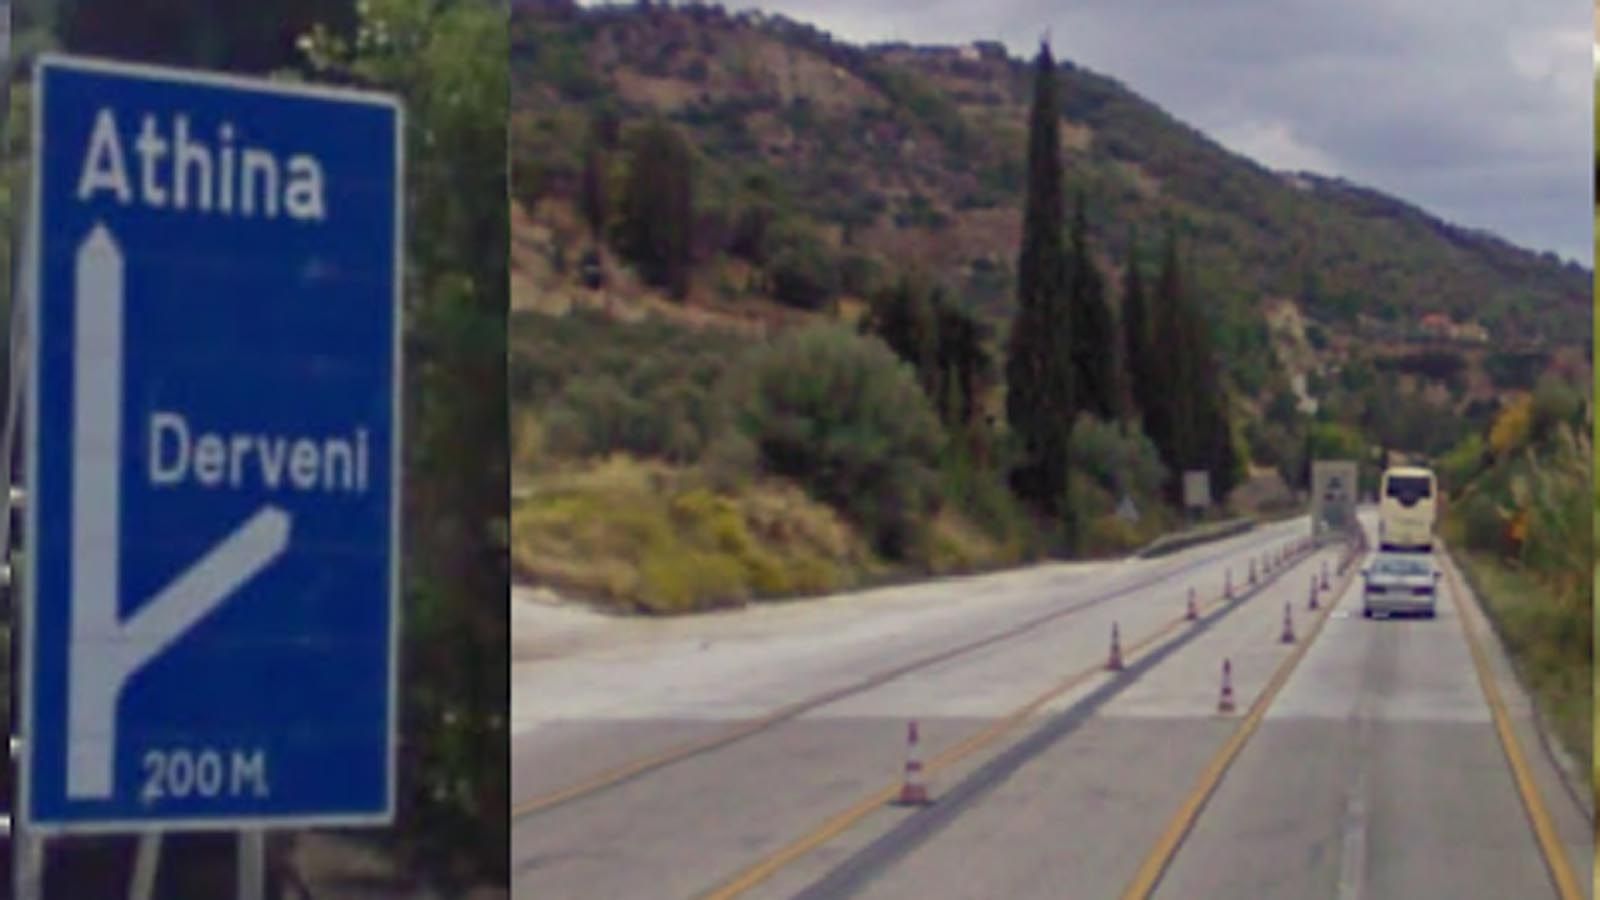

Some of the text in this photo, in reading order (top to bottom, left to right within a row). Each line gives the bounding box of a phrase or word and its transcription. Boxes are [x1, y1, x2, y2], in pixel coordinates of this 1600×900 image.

[78, 107, 325, 220] Athina
[150, 411, 369, 491] Derveni
[141, 750, 222, 799] 200
